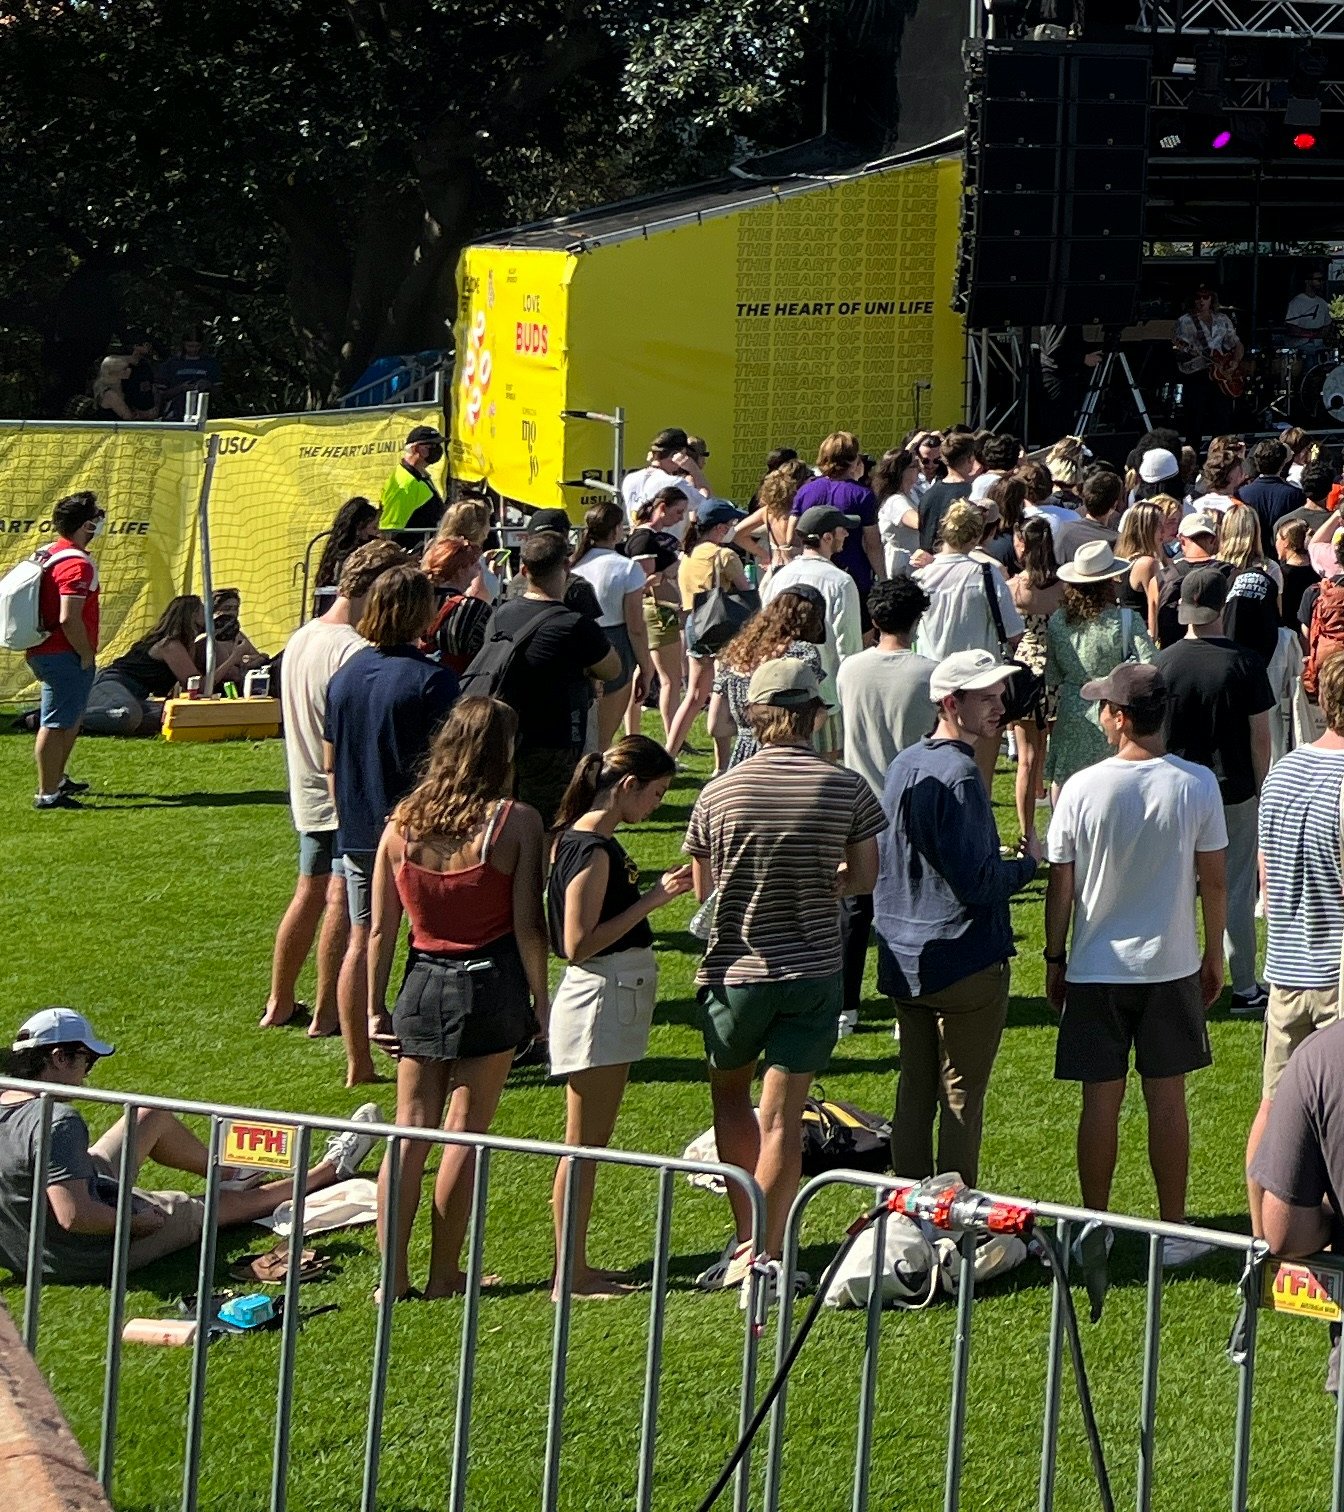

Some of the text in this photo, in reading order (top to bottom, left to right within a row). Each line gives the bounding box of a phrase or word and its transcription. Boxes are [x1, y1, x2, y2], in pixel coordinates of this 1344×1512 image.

[841, 185, 865, 198] OF
[868, 185, 900, 198] UNI
[903, 185, 938, 198] LIFE
[840, 199, 865, 212] OF
[868, 199, 899, 212] UNI
[902, 200, 938, 212] LIFE
[738, 213, 937, 226] THE HEART OF UNI LIFE
[738, 228, 936, 241] THE HEART OF UNI LIFE
[738, 243, 936, 256] THE HEART OF UNI LIFE
[737, 258, 935, 271] THE HEART OF UNI LIFE
[737, 272, 935, 286] THE HEART OF UNI LIFE
[736, 287, 934, 301] THE HEART OF UNI LIFE
[522, 294, 540, 313] LOVE
[736, 301, 934, 316] THE HEART OF UNI LIFE
[736, 316, 934, 331] THE HEART OF UNI LIFE
[515, 322, 549, 356] BUDS
[736, 330, 934, 346] THE HEART OF UNI LIFE
[735, 345, 934, 361] THE HEART OF UNI LIFE
[735, 359, 934, 376] THE HEART OF UNI LIFE
[735, 378, 769, 392] THE
[772, 377, 834, 391] HEART
[836, 376, 860, 389] OF
[862, 375, 893, 389] UNI
[734, 393, 769, 406] THE
[772, 392, 834, 405] HEART
[836, 391, 860, 404] OF
[862, 390, 893, 403] UNI
[734, 408, 769, 422] THE
[771, 407, 833, 420] HEART
[835, 405, 859, 419] OF
[862, 404, 893, 418] UNI
[734, 423, 768, 437] THE
[771, 421, 833, 435] HEART
[835, 420, 859, 434] OF
[862, 419, 892, 433] UNI
[218, 437, 257, 455] USU
[299, 447, 321, 458] THE
[321, 445, 360, 458] HEART
[361, 443, 375, 455] OF
[377, 440, 396, 453] UNI
[733, 438, 768, 452] THE
[771, 437, 821, 450] HEAR
[861, 434, 892, 448] UNI
[108, 522, 150, 535] LIFE
[232, 1126, 284, 1153] TFH
